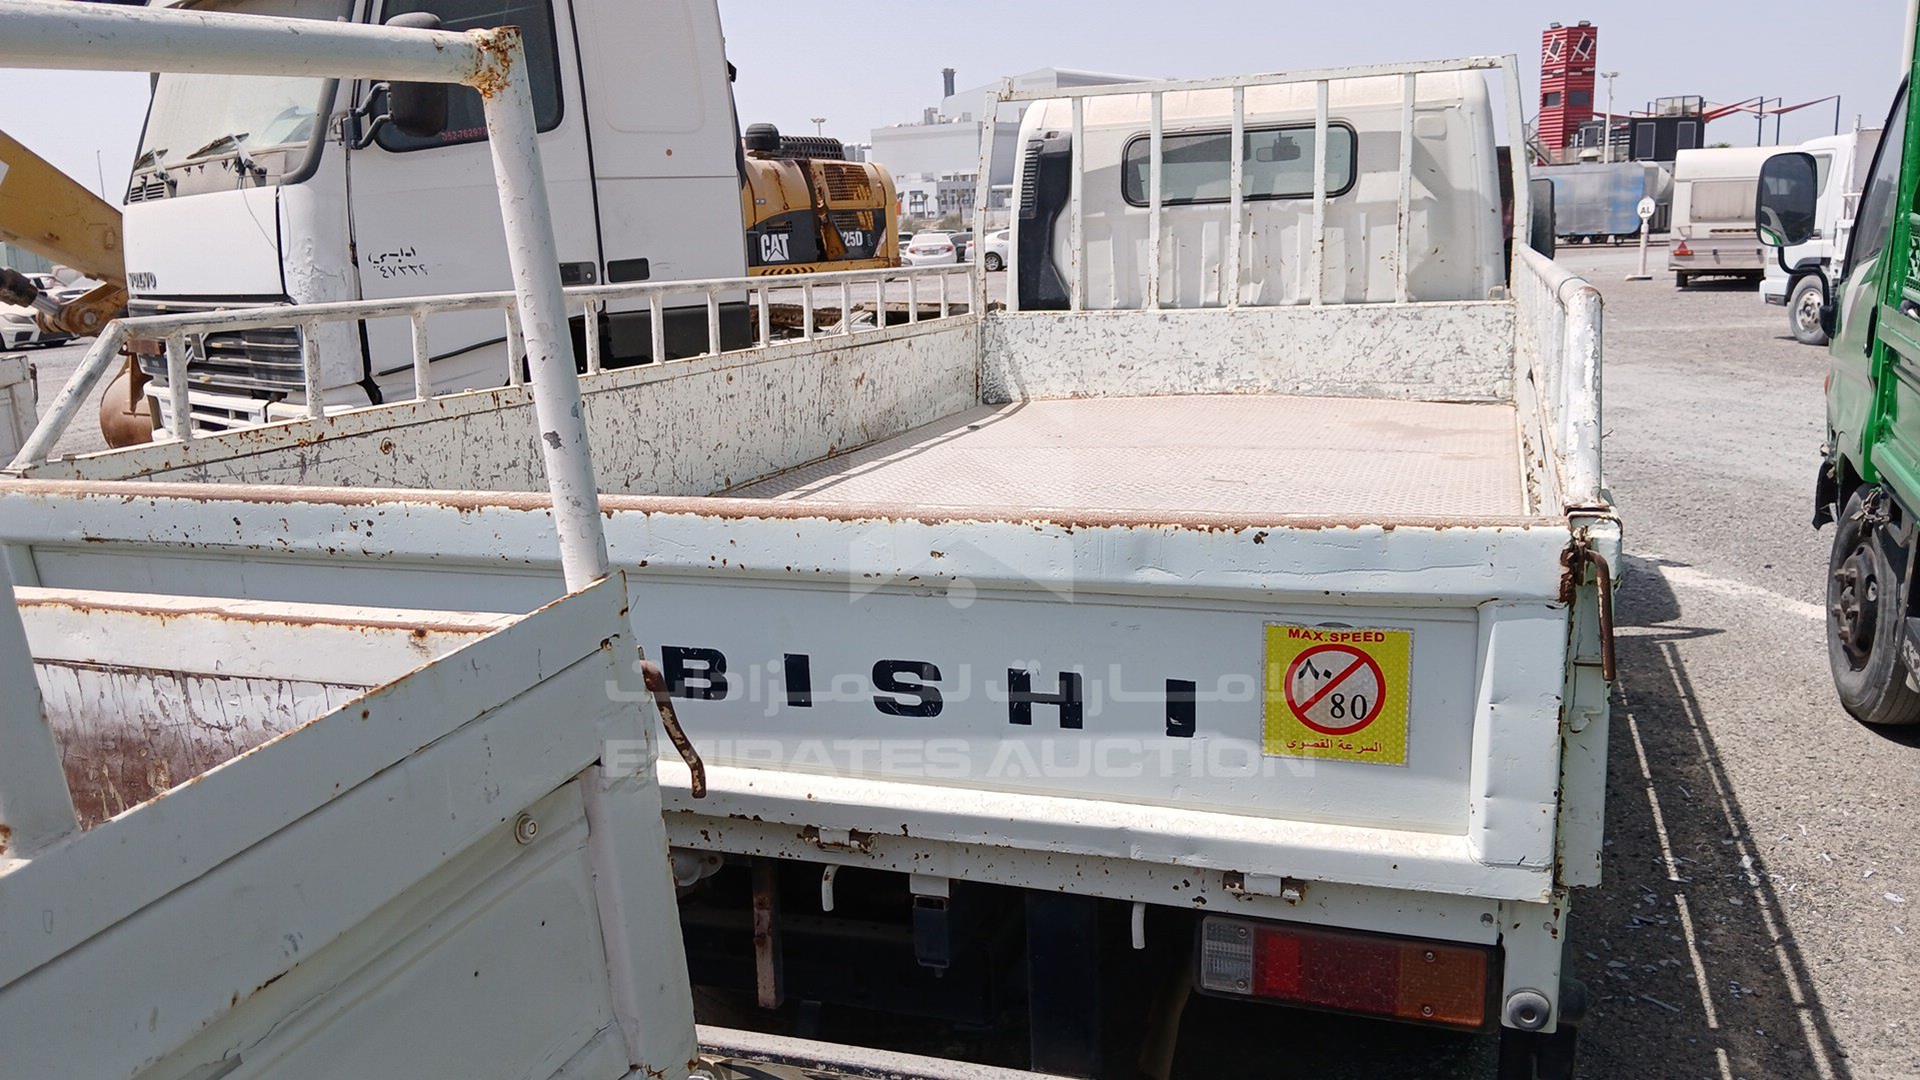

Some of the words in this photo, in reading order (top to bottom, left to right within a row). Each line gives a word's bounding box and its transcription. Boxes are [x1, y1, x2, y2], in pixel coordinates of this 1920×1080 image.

[760, 232, 790, 262] CAT
[841, 231, 863, 247] 25D
[128, 272, 157, 290] VOLVO
[1287, 628, 1386, 644] MAX.SPEED
[1298, 658, 1333, 681] ٨٠
[1330, 693, 1368, 720] 80
[1338, 739, 1382, 755] السرعة
